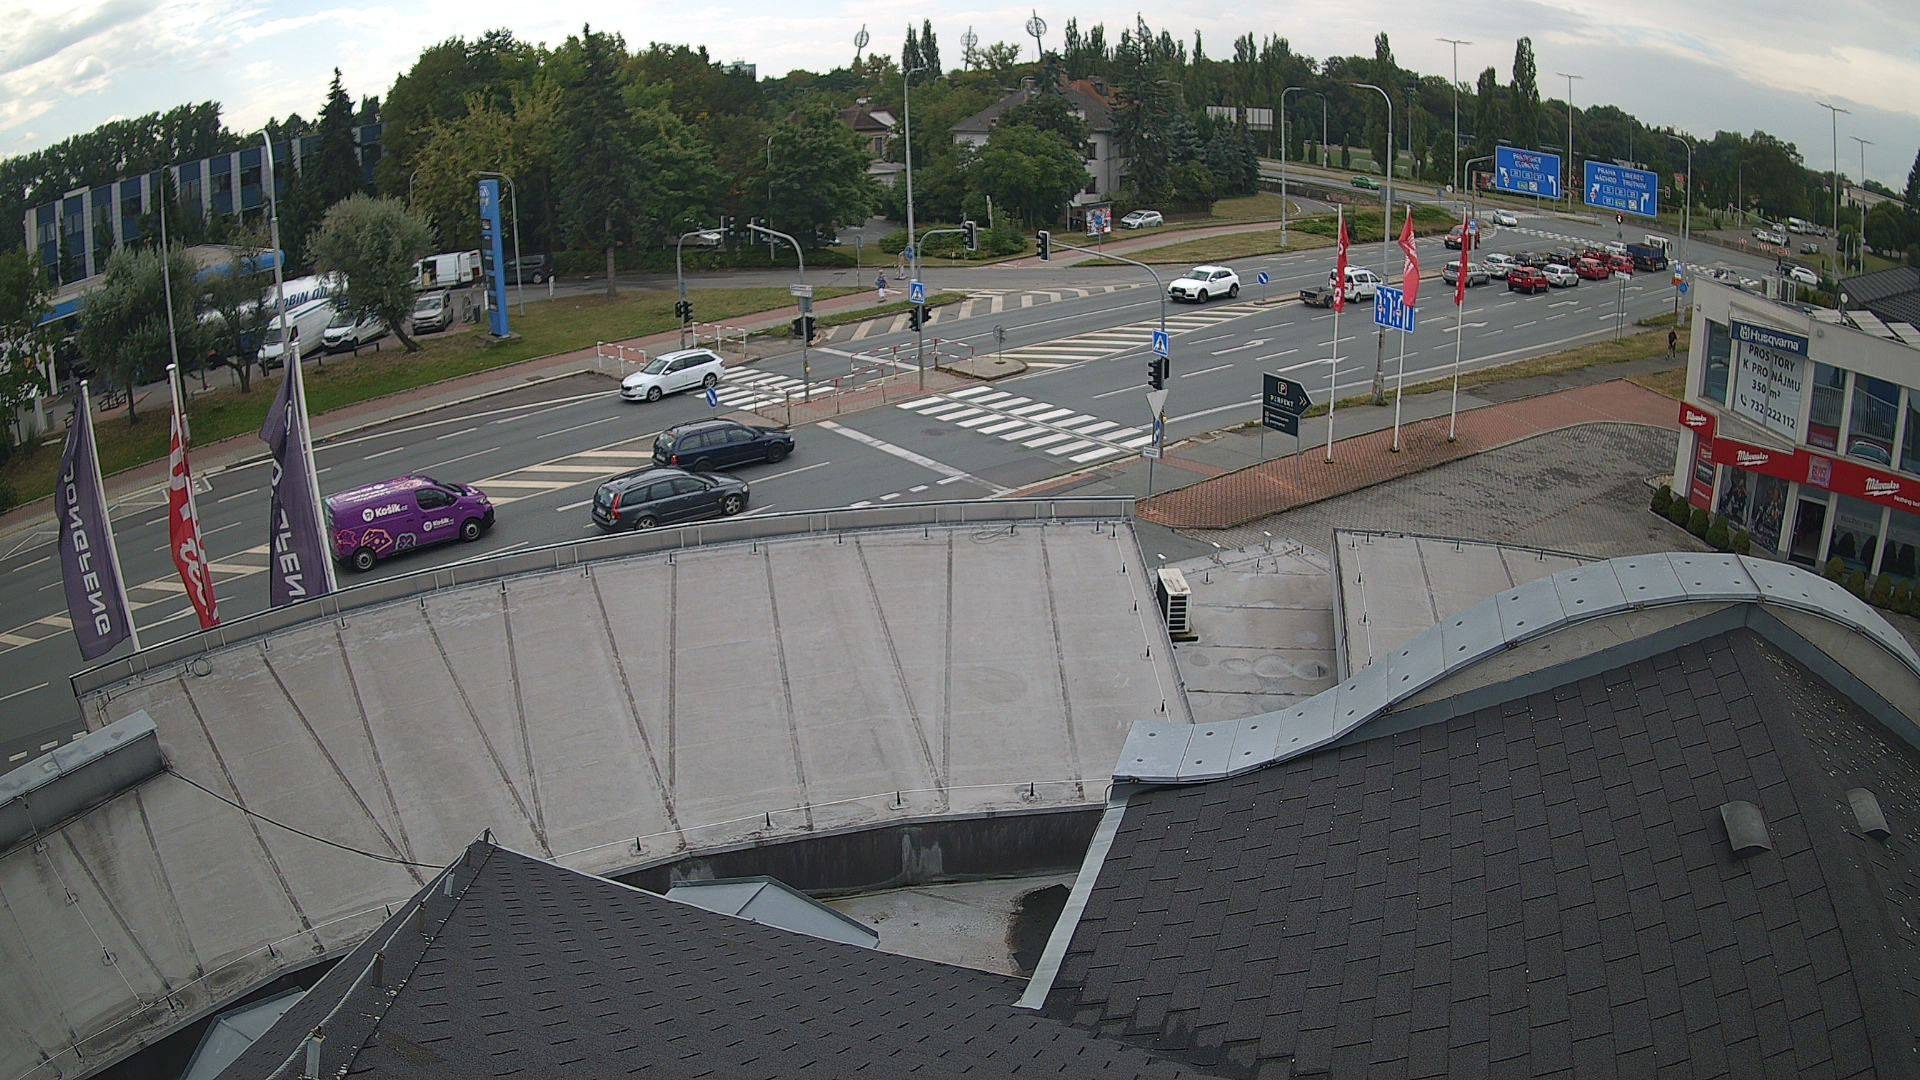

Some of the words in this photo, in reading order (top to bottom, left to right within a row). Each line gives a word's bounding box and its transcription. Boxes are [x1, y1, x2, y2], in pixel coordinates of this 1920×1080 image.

[1751, 330, 1799, 351] Husqvarna
[1743, 359, 1750, 369] K
[1752, 379, 1767, 394] 350
[1750, 399, 1764, 414] 732
[1865, 477, 1900, 491] Milwaukee
